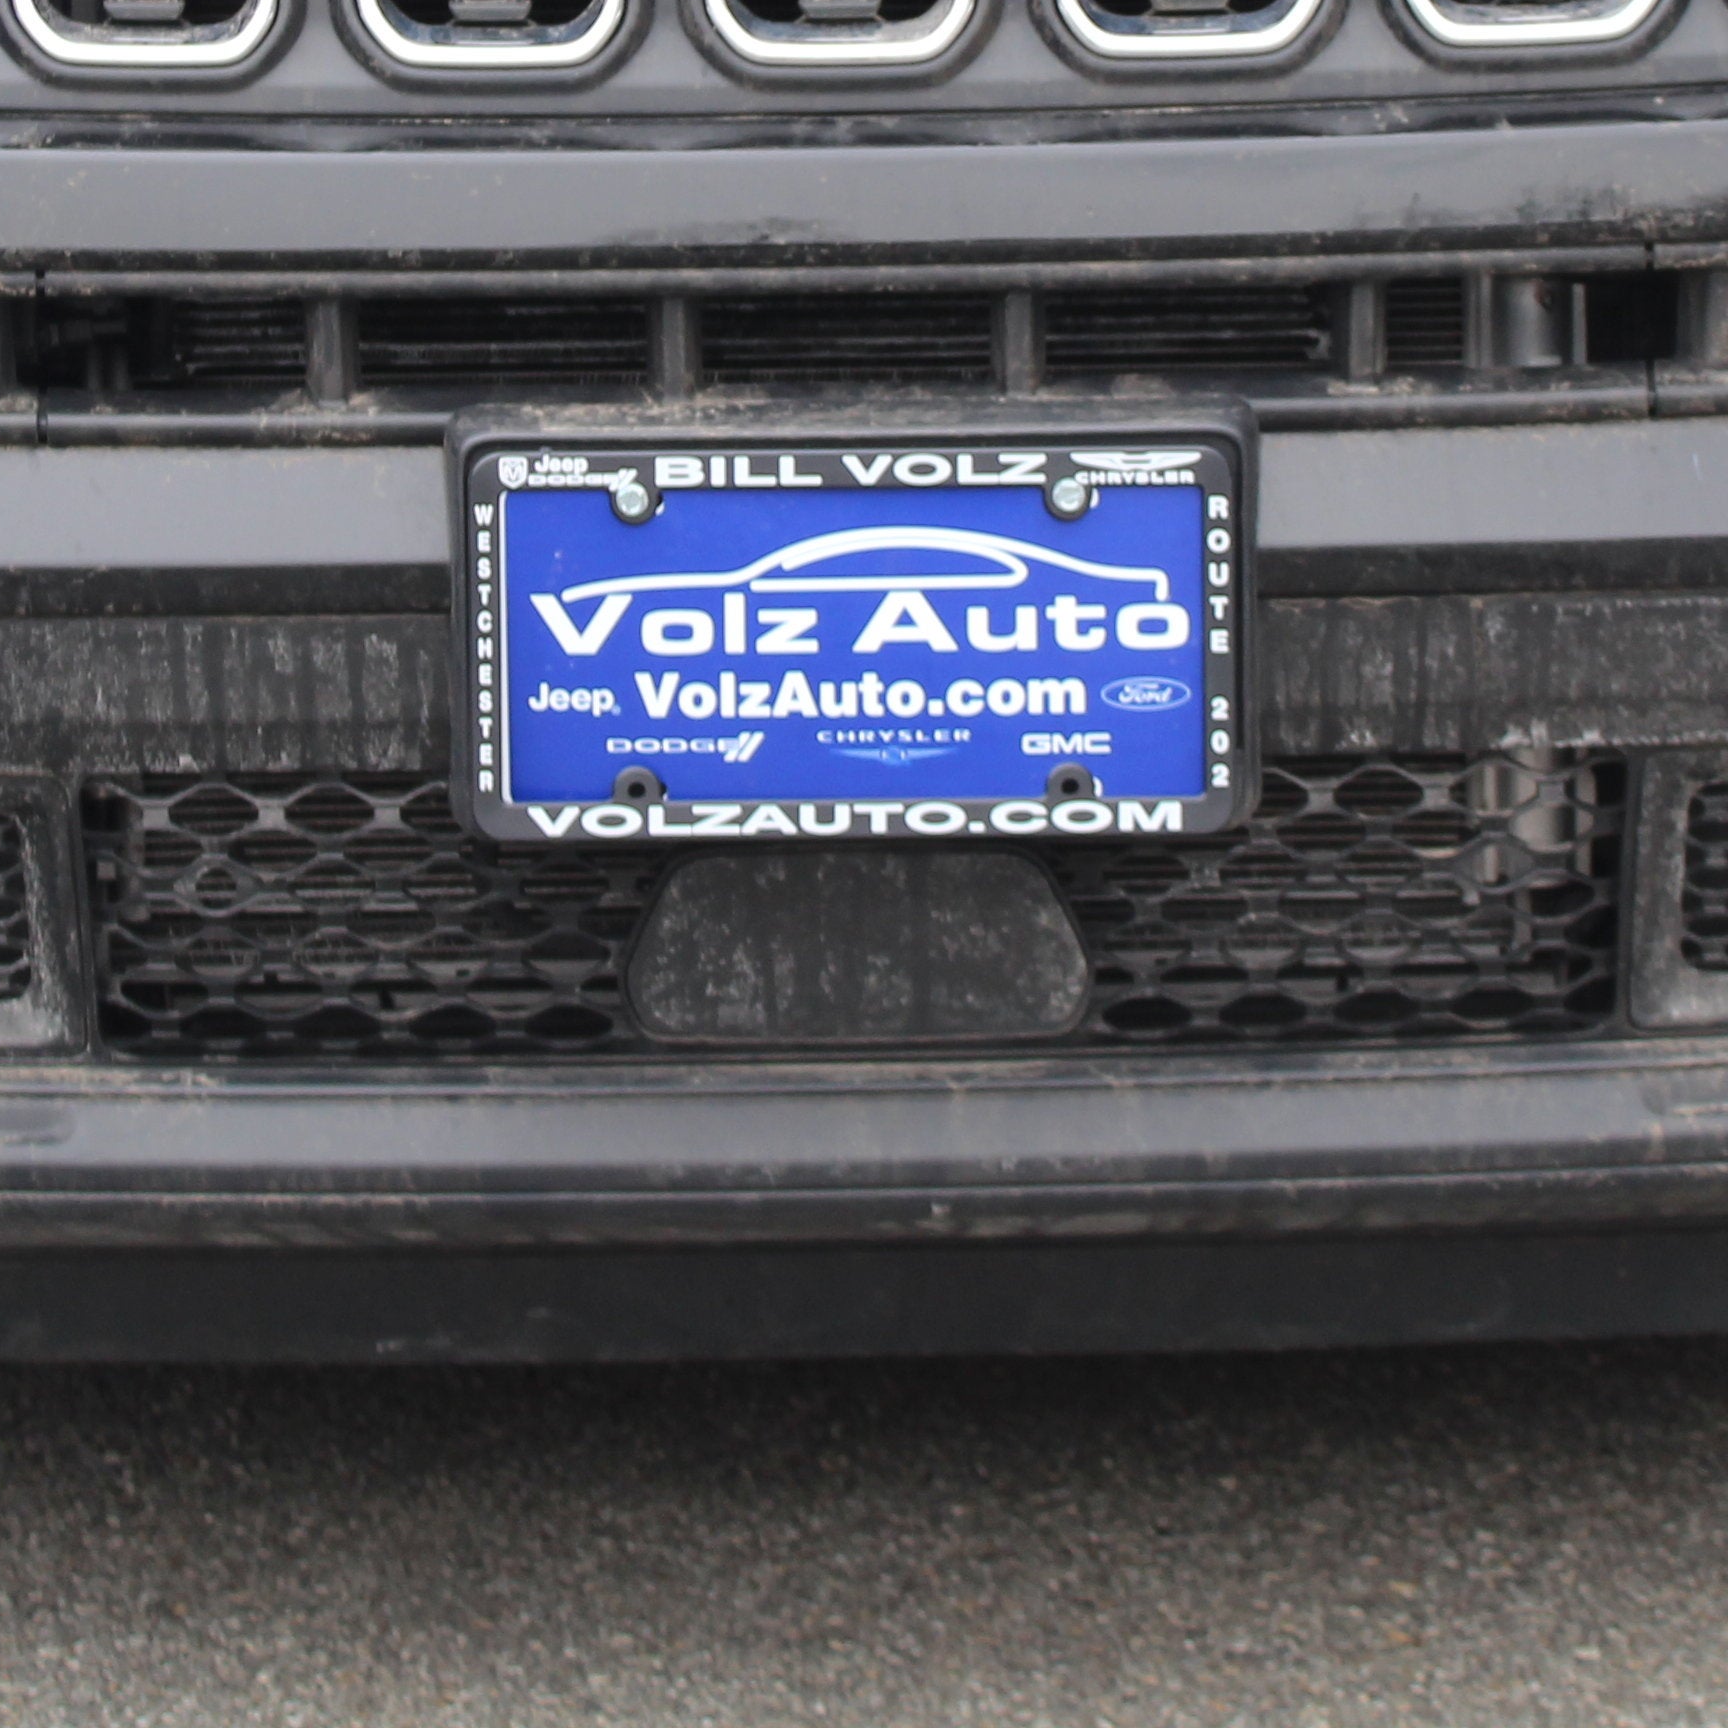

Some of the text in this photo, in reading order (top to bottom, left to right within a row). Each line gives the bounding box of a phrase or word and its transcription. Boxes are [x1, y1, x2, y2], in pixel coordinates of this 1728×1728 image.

[533, 453, 590, 477] Jeep
[655, 453, 1047, 488] BILL VOLZ
[1074, 469, 1196, 485] CHRYSLER
[530, 590, 1191, 656] Volz Auto
[1206, 494, 1232, 788] ROUTE 202
[473, 503, 494, 792] WESTCHESTER
[527, 681, 616, 718] Jeep
[634, 669, 1087, 719] VolzAuto.com
[605, 736, 739, 755] DODGE
[816, 728, 971, 744] CHRYSLER
[1021, 731, 1112, 755] GMC
[527, 801, 1183, 839] VOLZAUTO.COM
